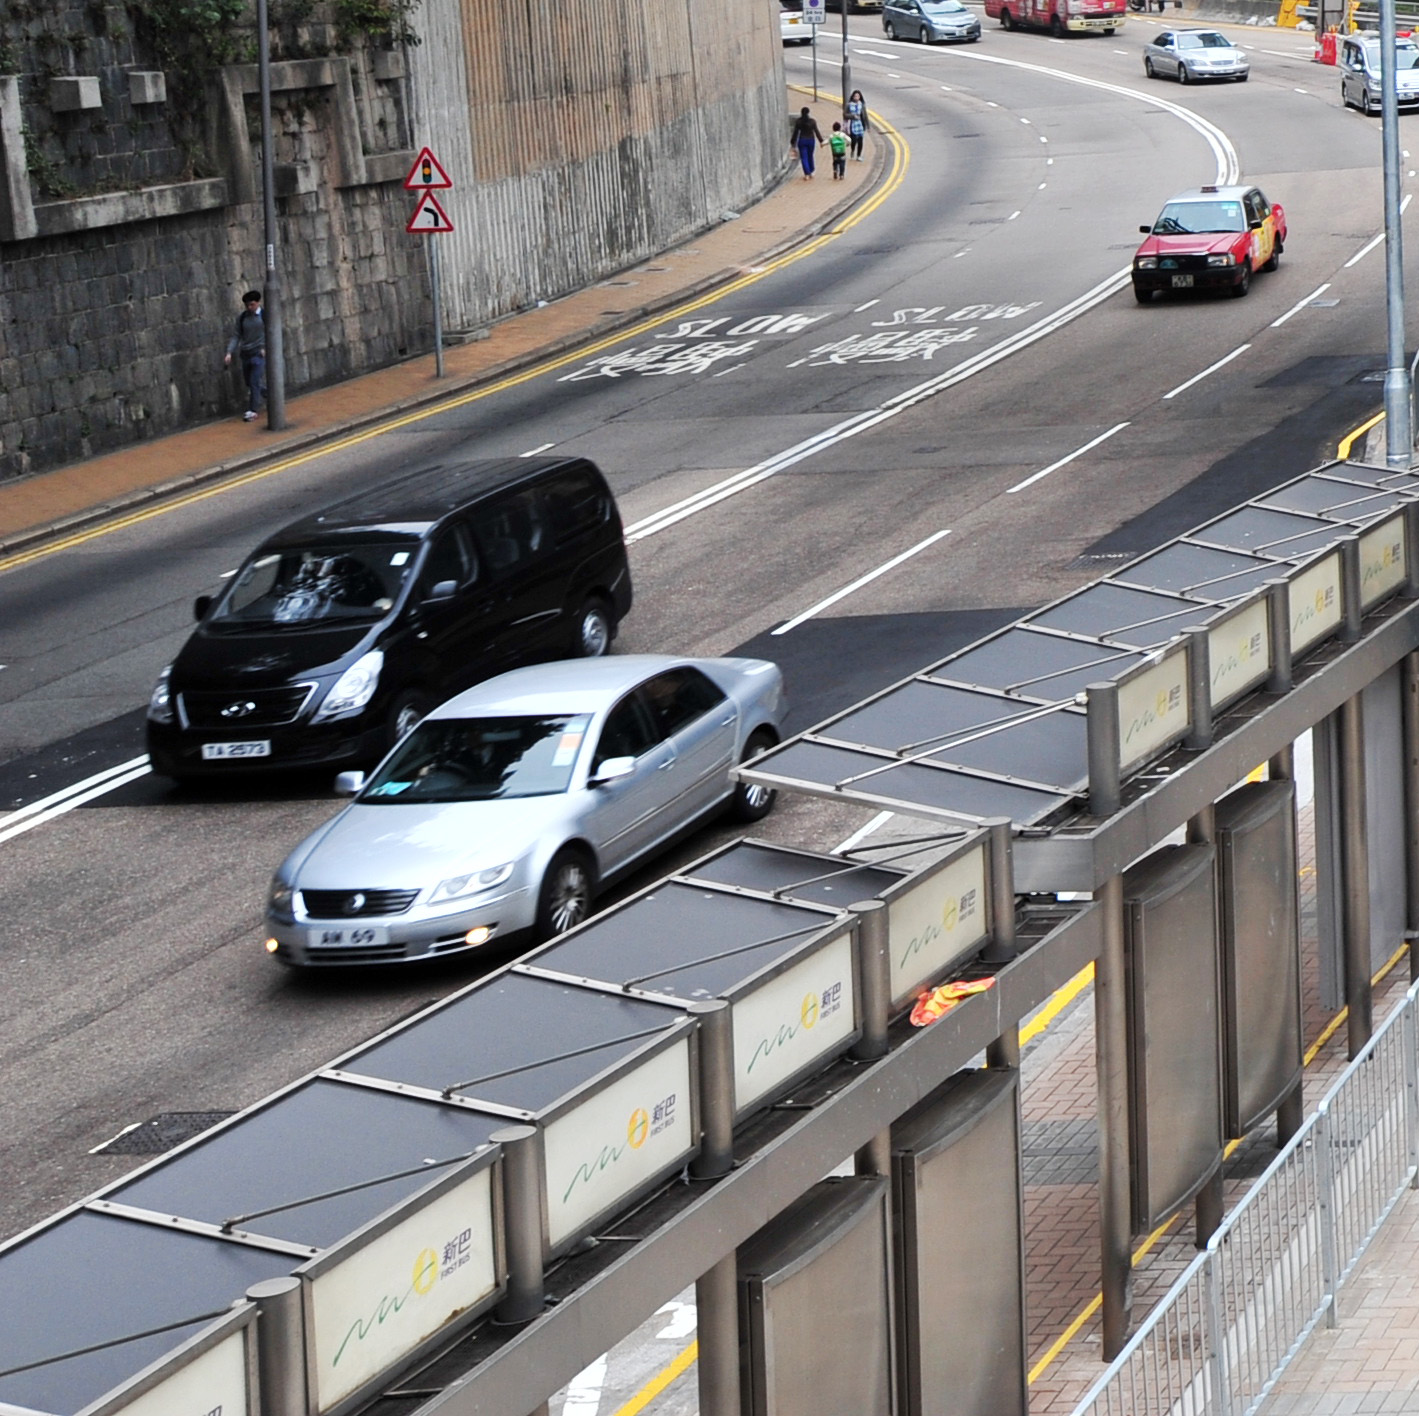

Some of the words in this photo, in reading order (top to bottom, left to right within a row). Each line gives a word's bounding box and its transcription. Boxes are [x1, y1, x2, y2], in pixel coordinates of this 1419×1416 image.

[655, 313, 833, 339] SLOW
[871, 301, 1043, 327] SLOW
[821, 981, 842, 1009] 新巴
[652, 1093, 676, 1125] 新巴
[442, 1227, 472, 1266] 新巴
[440, 1262, 457, 1281] FIRST
[459, 1251, 471, 1268] BUS
